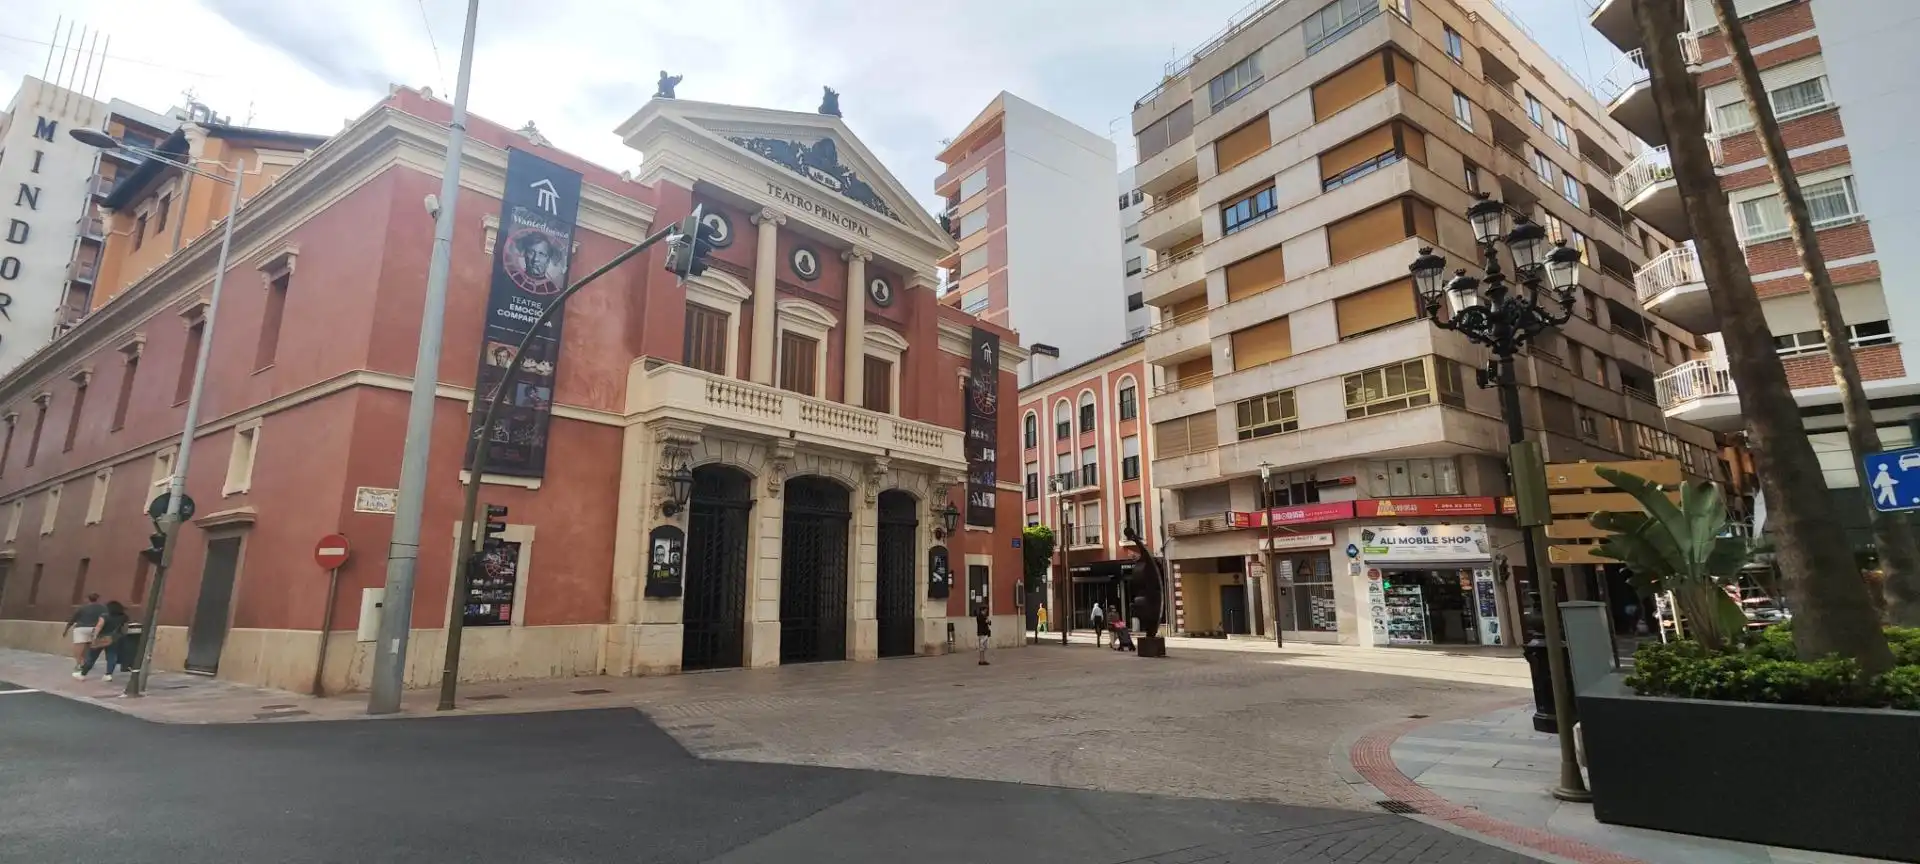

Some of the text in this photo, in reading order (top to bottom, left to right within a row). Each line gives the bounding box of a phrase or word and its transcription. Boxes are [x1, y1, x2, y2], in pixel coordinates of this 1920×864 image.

[767, 183, 813, 212] TEATRO
[0, 115, 58, 345] MINDOR
[1380, 535, 1471, 545] ALI MOBILE SHOP
